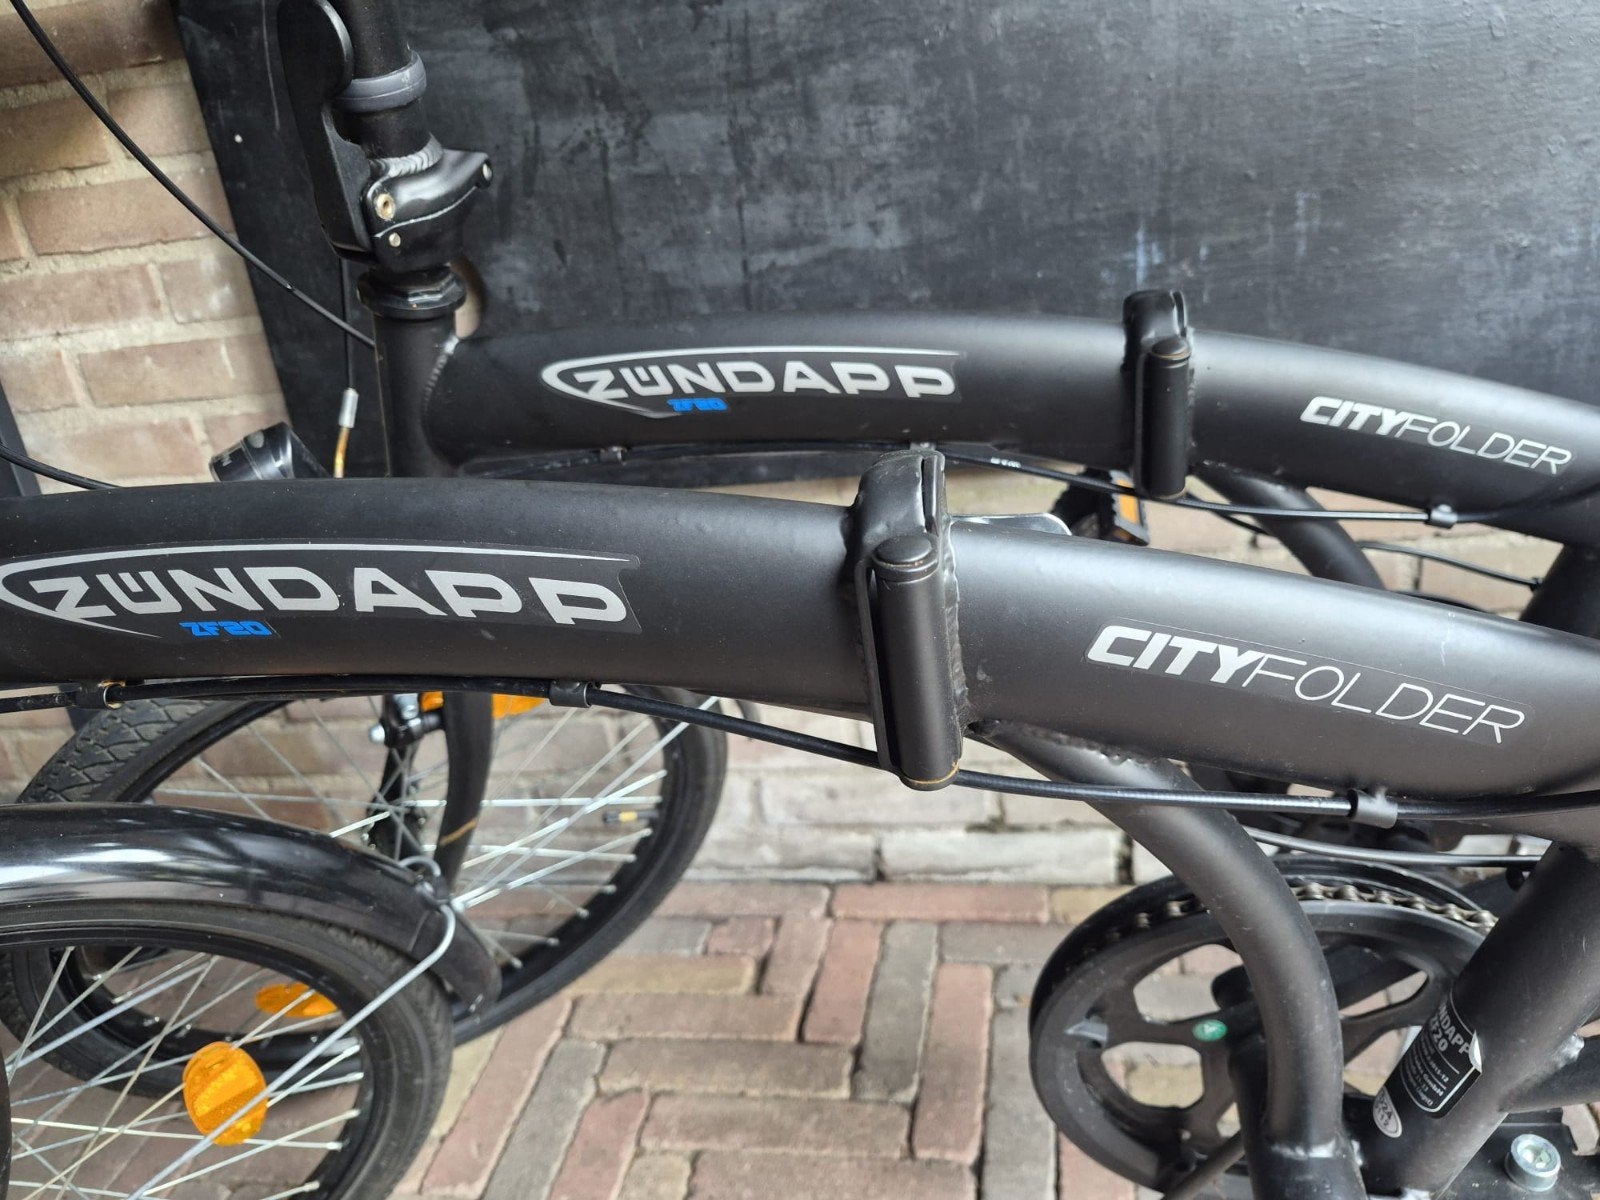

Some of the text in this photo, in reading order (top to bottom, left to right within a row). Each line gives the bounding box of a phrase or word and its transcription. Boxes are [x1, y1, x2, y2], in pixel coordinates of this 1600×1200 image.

[574, 360, 956, 399] ZÜNDAPP
[1300, 396, 1573, 476] CITYFOLDER
[31, 566, 628, 625] ZÜNDAPP
[178, 620, 273, 637] ZF20
[1087, 625, 1526, 743] CITYFOLDER
